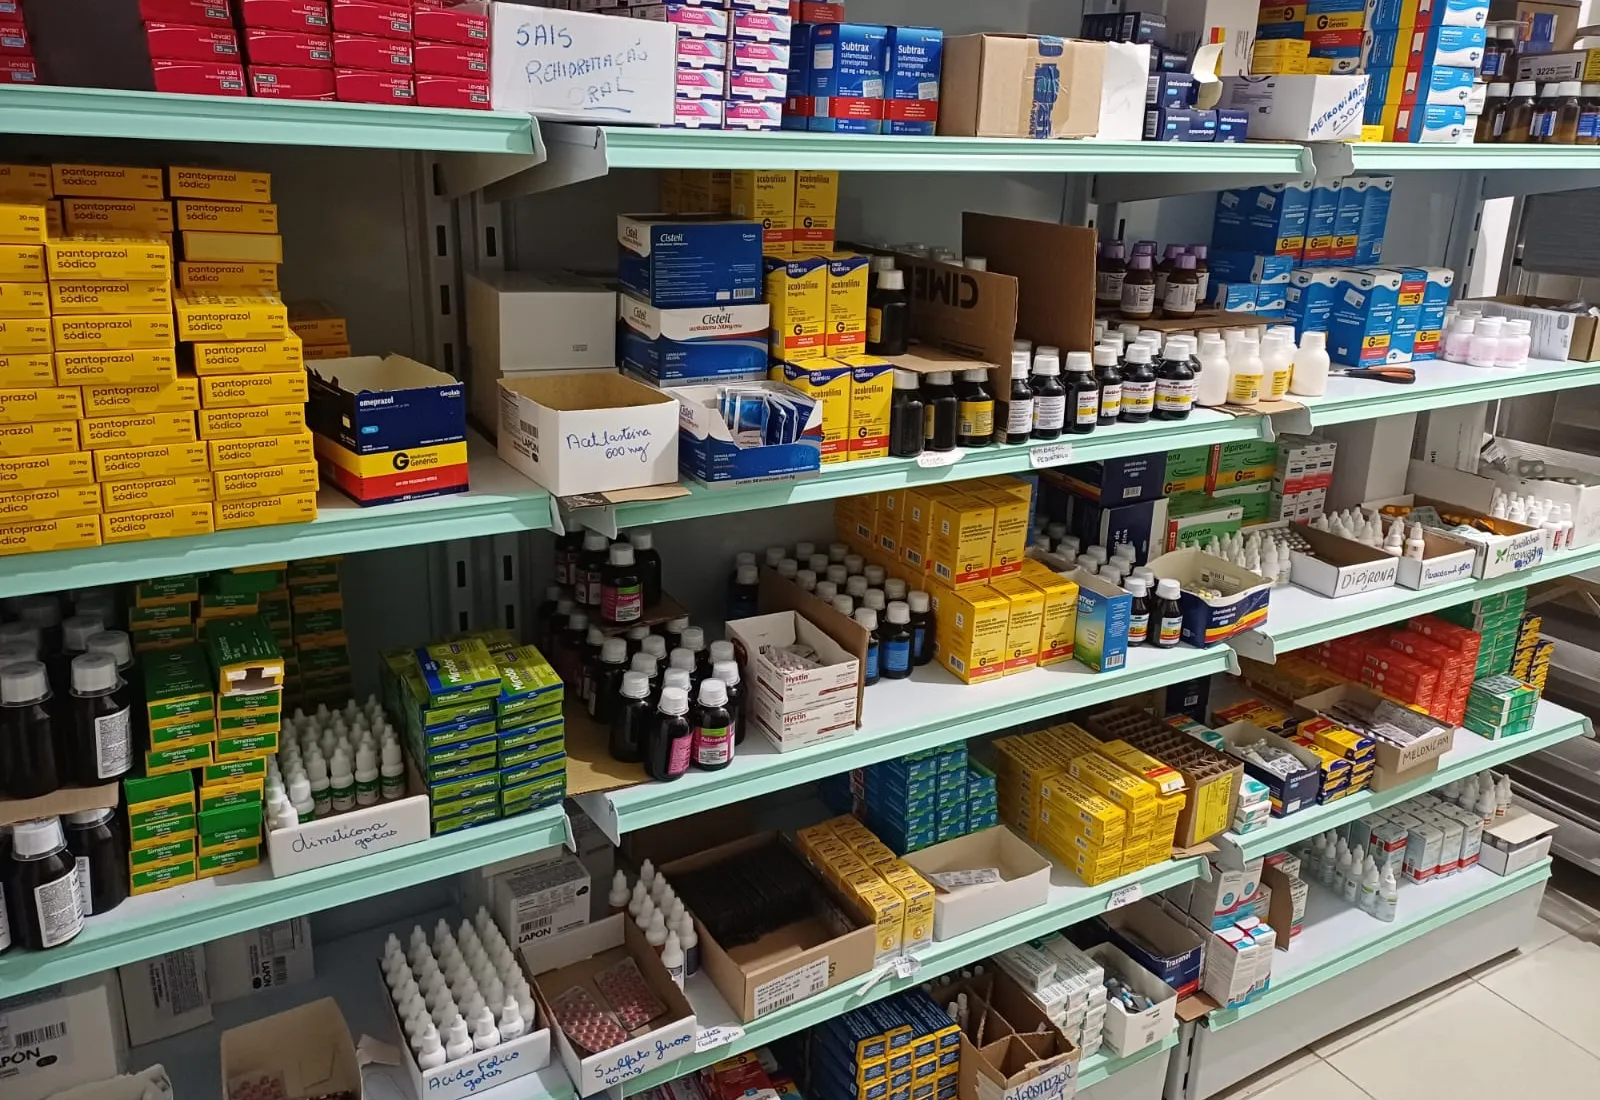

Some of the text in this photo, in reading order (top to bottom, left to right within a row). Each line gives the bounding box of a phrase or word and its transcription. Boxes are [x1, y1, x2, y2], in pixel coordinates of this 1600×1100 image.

[516, 23, 572, 48] SAIS
[841, 41, 870, 52] Subtrax
[898, 45, 925, 55] Subtrax
[1536, 66, 1556, 76] 3225
[566, 75, 634, 105] ORAL
[61, 168, 125, 179] pantoprazol
[178, 172, 236, 182] pantoprazol
[63, 177, 97, 186] sódico
[179, 180, 210, 189] sódico
[73, 203, 136, 213] pantoprazol
[186, 204, 243, 213] pantoprazol
[75, 211, 108, 220] sódico
[187, 212, 217, 221] sódico
[660, 233, 683, 242] Cisteil
[57, 249, 128, 259] pantoprazol
[58, 259, 96, 268] sódico
[188, 266, 244, 274] pantoprazol
[189, 274, 219, 282] sódico
[59, 284, 129, 293] pantoprazol
[60, 294, 98, 303] sódico
[187, 312, 250, 322] pantoprazol
[702, 313, 732, 325] Cisteil
[62, 320, 132, 330] pantoprazol
[188, 322, 222, 330] sódico
[64, 330, 101, 339] sódico
[204, 344, 266, 354] pantoprazol
[65, 353, 134, 364] pantoprazol
[206, 355, 239, 364] sódico
[66, 364, 104, 374] sódico
[211, 378, 272, 388] pantoprazol
[92, 384, 160, 396] pantoprazol
[212, 388, 245, 397] sódico
[854, 385, 884, 396] acebrofilina
[94, 396, 130, 405] sódico
[359, 396, 394, 407] omeprazol
[208, 410, 269, 421] pantoprazol
[88, 417, 155, 429] pantoprazol
[209, 420, 242, 429] sódico
[90, 428, 126, 438] sódico
[218, 440, 278, 451] pantoprazol
[1223, 443, 1252, 453] dipirona
[104, 448, 169, 462] pantoprazol
[219, 450, 251, 459] sódico
[605, 446, 625, 459] 600
[0, 459, 49, 471] toprazol
[105, 460, 141, 470] sódico
[410, 457, 438, 466] Genérico
[224, 469, 283, 481] pantoprazol
[112, 478, 176, 491] pantoprazol
[225, 480, 257, 490] sódico
[113, 490, 148, 501] sódico
[222, 498, 281, 511] pantoprazol
[110, 510, 174, 524] pantoprazol
[223, 510, 255, 520] sódico
[111, 522, 146, 533] sódico
[1181, 527, 1211, 540] dipirona
[785, 674, 808, 683] Hystin
[784, 712, 806, 724] Hystin
[1402, 736, 1449, 765] MELOXICAM
[292, 820, 388, 852] dimeticona
[355, 828, 398, 850] gotas
[519, 927, 552, 944] LAPON
[262, 961, 270, 988] LAPON
[697, 1028, 721, 1040] ulfato
[0, 1047, 40, 1068] PON
[595, 1051, 650, 1078] Sulfato
[429, 1069, 474, 1090] Acido
[464, 1068, 502, 1091] gotas
[605, 1076, 619, 1085] 40
